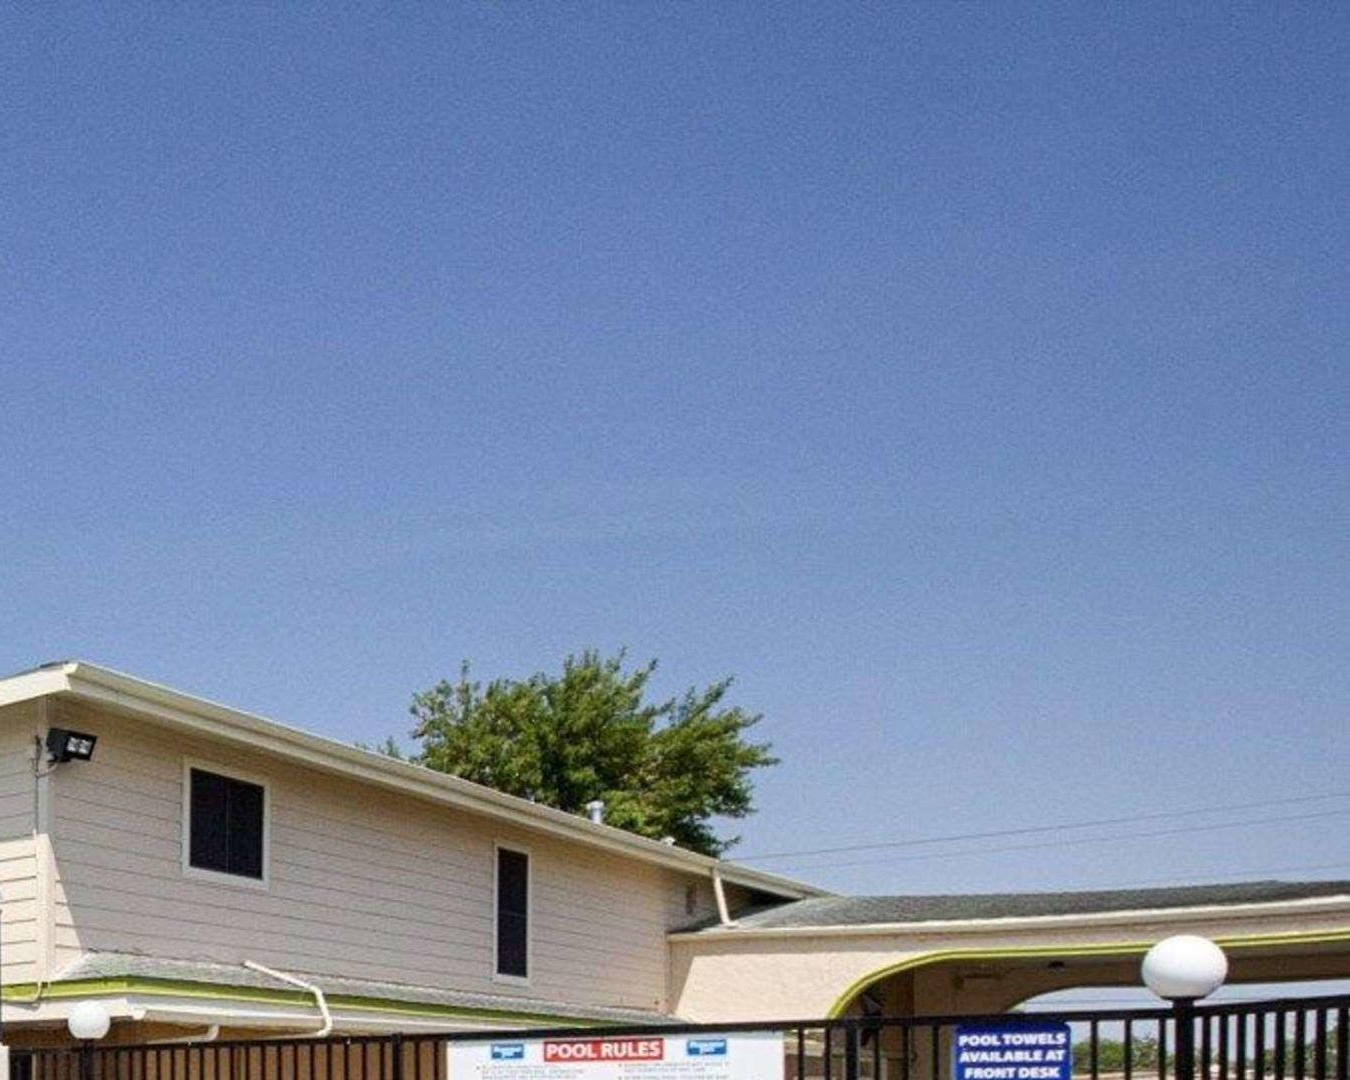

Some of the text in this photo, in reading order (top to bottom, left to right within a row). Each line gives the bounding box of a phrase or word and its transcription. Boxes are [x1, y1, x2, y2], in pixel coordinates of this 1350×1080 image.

[958, 1032, 1066, 1047] POOL TOWELS
[546, 1041, 662, 1059] POOL RULES
[959, 1050, 1065, 1063] AVAILABLE AT
[964, 1067, 1060, 1079] FRONT DESK
